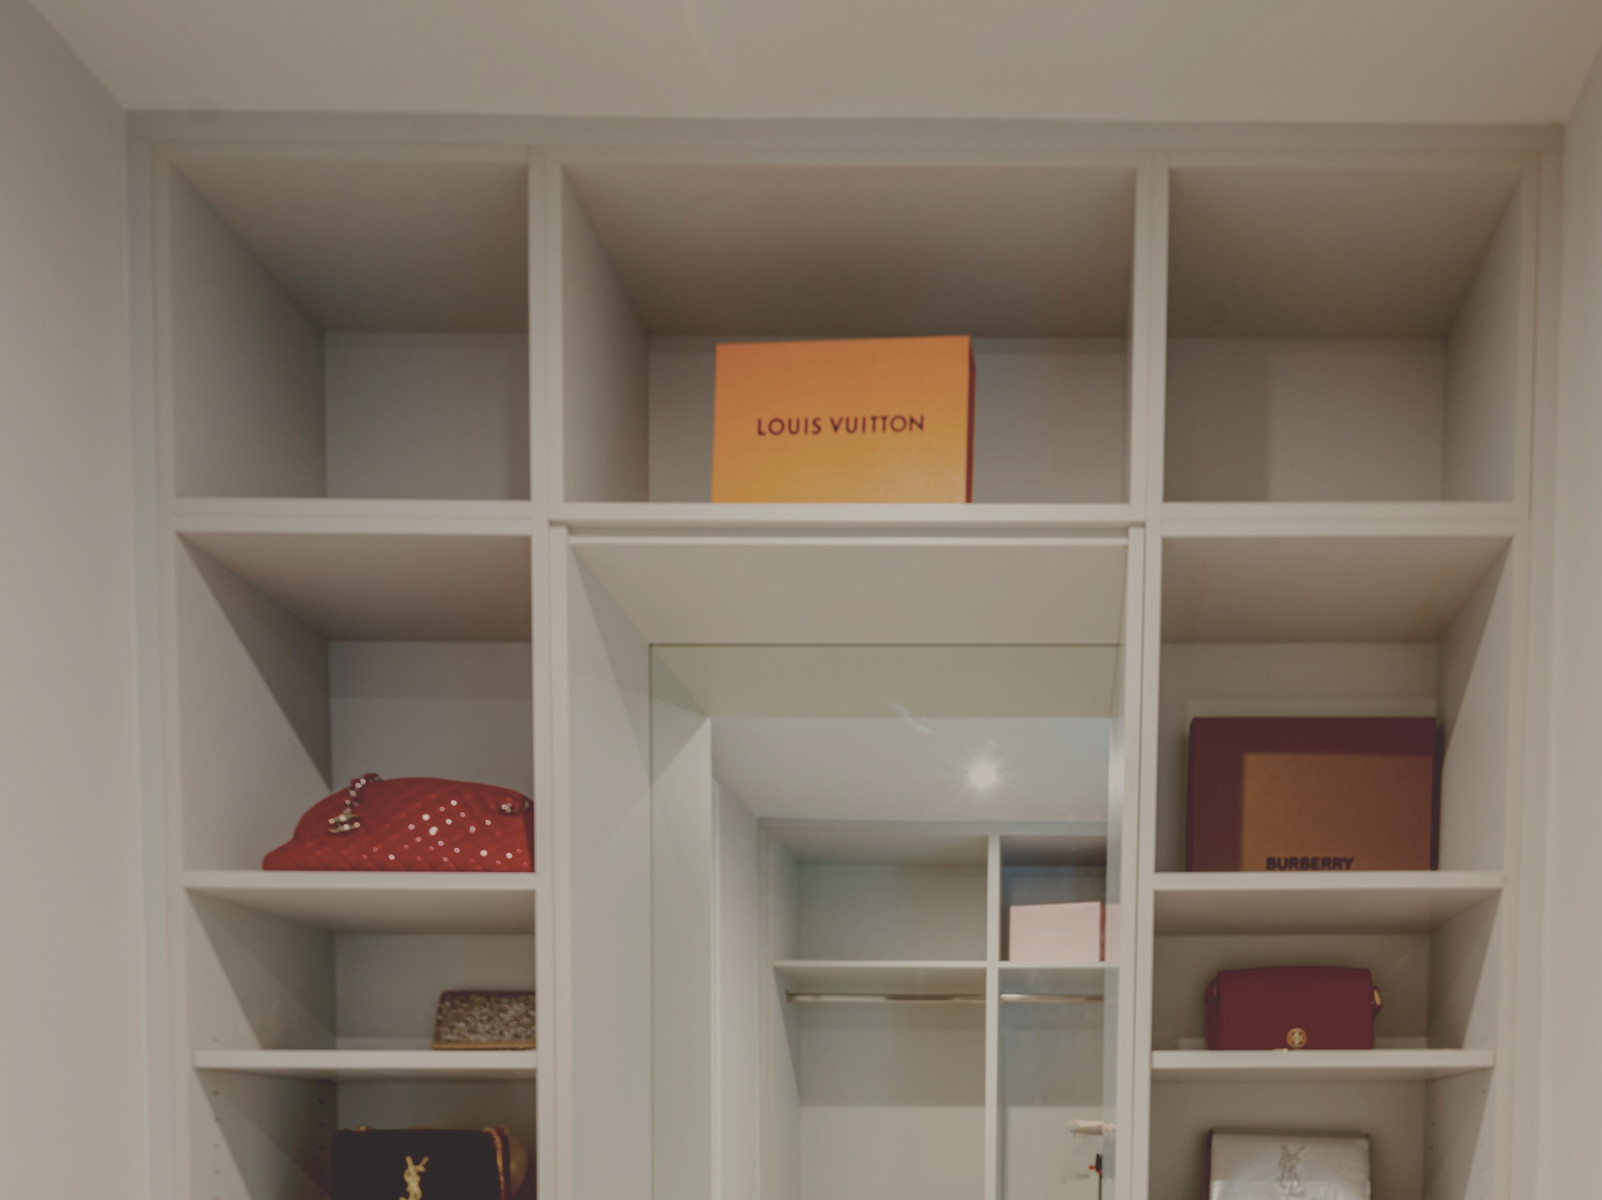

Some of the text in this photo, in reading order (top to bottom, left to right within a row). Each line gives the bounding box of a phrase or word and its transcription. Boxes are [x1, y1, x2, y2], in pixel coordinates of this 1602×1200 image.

[757, 414, 925, 436] LOUIS VUITTON
[1266, 856, 1355, 871] BURBERRY
